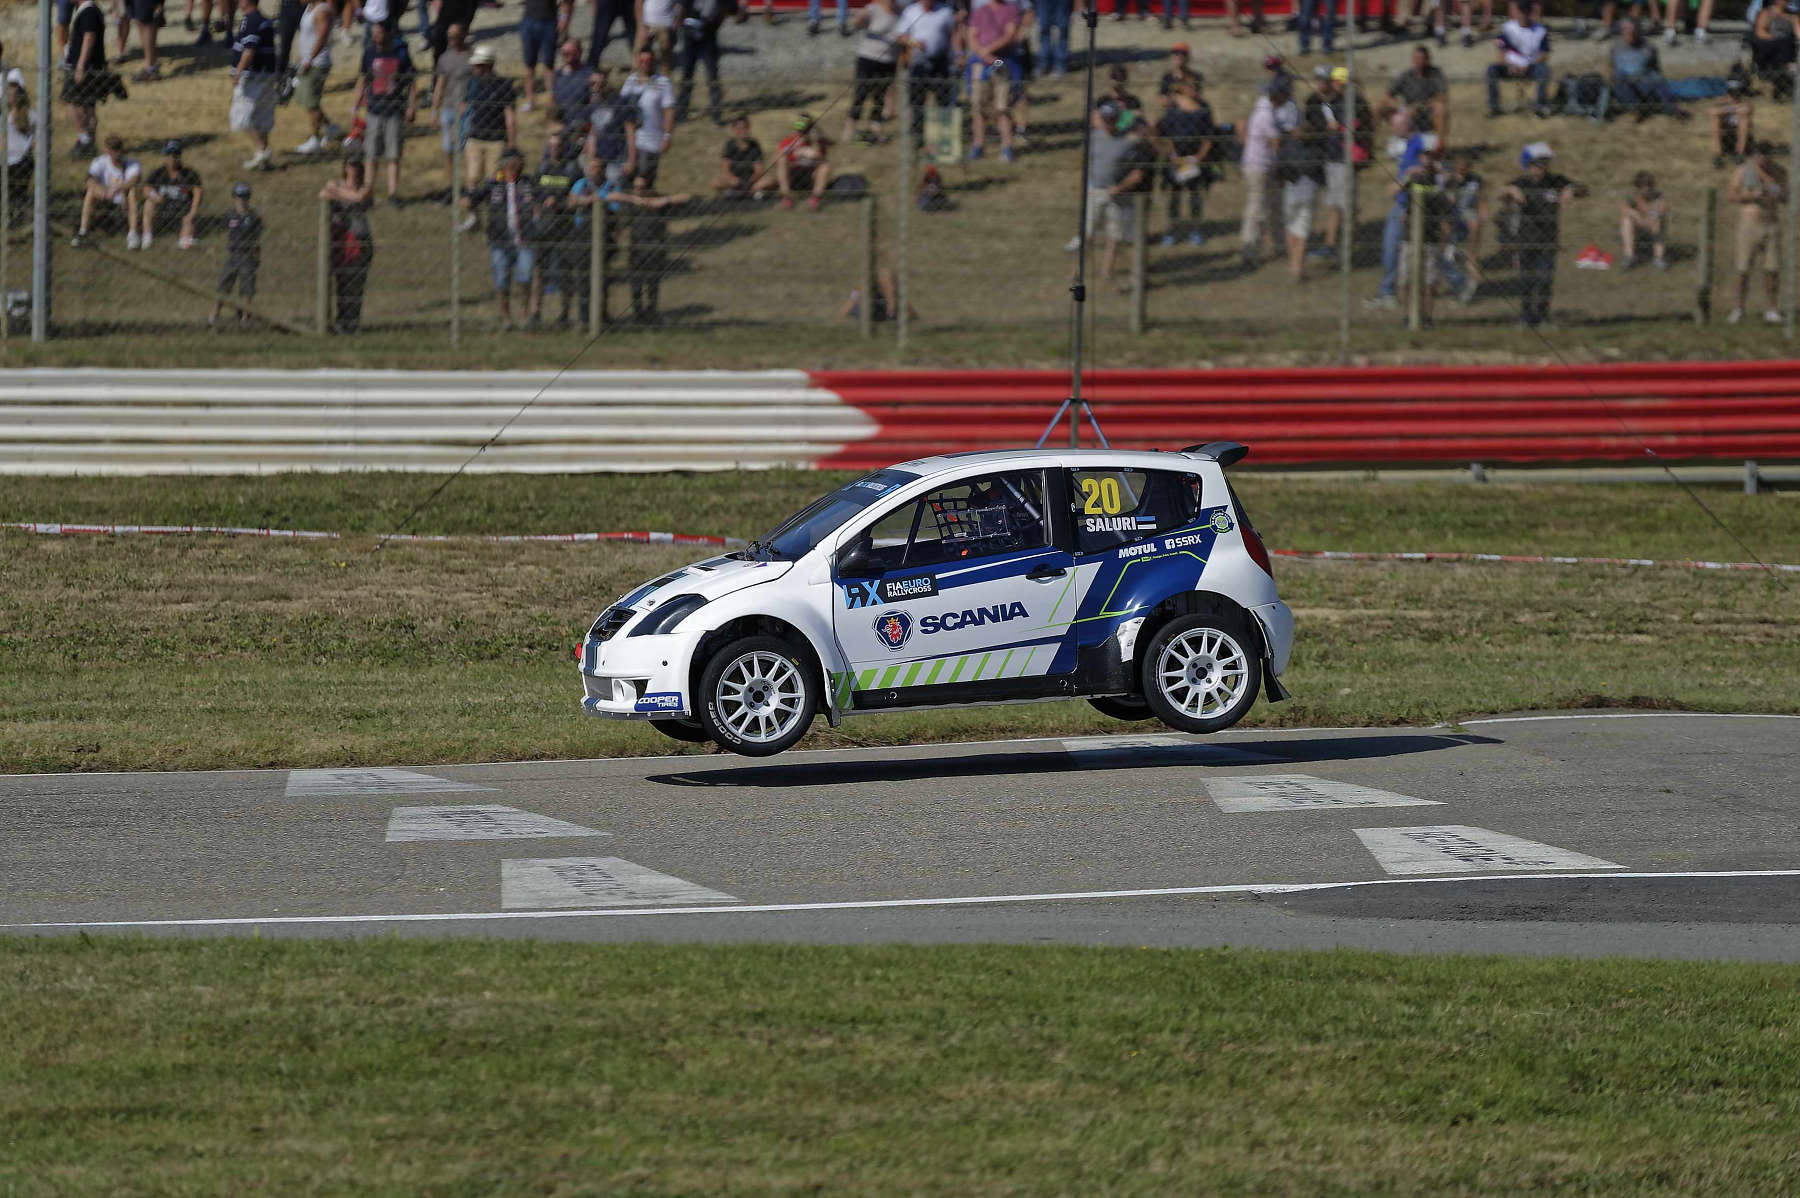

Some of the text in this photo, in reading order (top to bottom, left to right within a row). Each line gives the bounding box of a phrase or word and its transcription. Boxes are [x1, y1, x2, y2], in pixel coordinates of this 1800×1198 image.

[1081, 477, 1121, 515] 20
[1085, 515, 1137, 532] SALURI
[1118, 542, 1157, 558] MOTUL
[887, 586, 932, 598] RALLYCROSS
[919, 602, 1029, 635] SCANIA
[638, 696, 679, 704] COOPER
